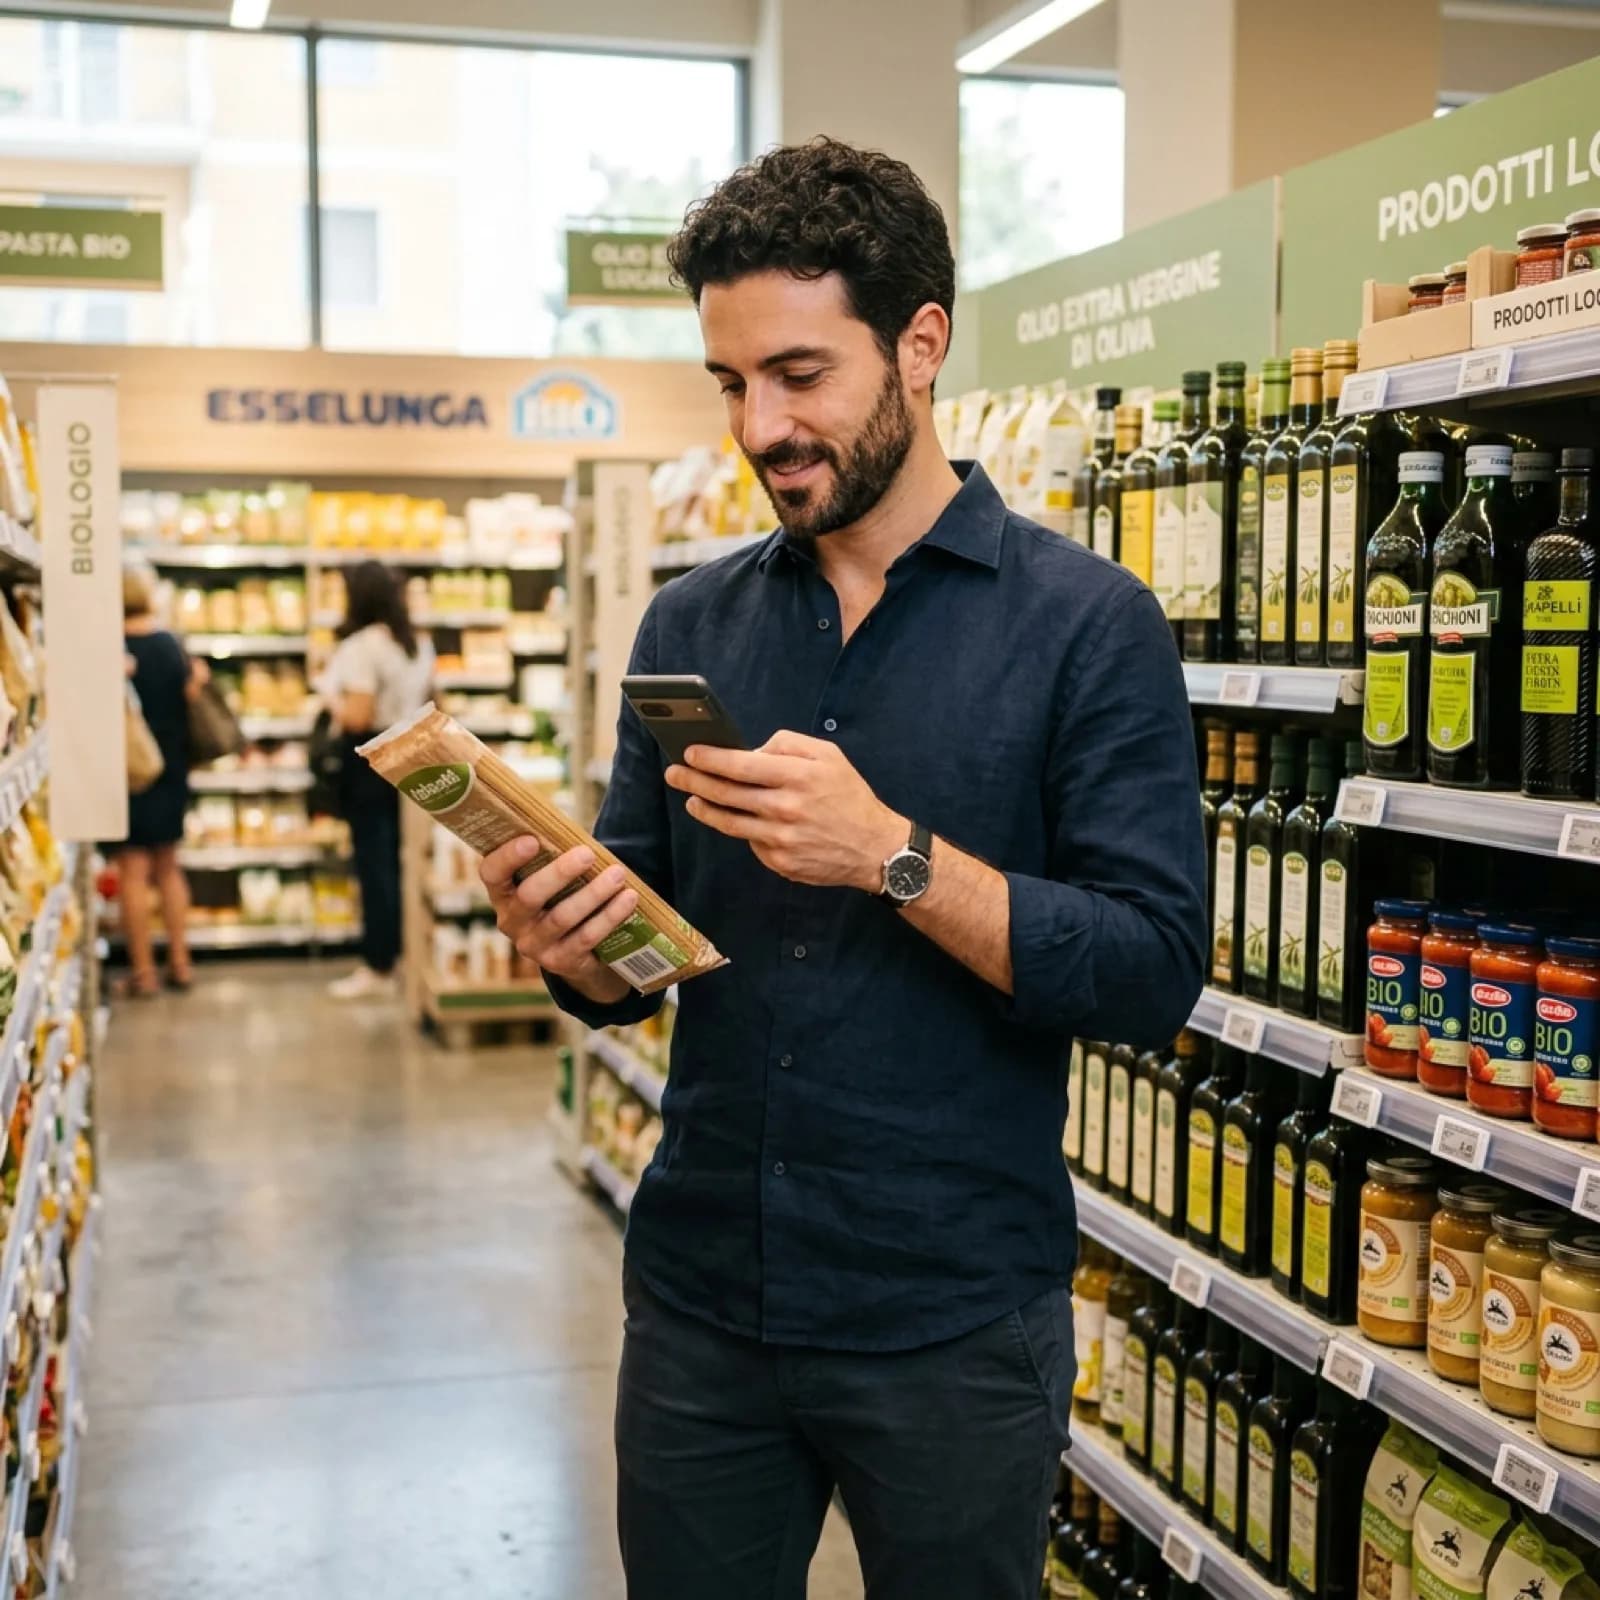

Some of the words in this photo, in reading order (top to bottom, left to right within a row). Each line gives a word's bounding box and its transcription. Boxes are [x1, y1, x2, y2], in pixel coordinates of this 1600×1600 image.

[1378, 143, 1554, 242] PRODOTTI
[0, 230, 79, 258] PASTA
[82, 233, 132, 260] BIO
[1016, 302, 1061, 344] OLIO
[1062, 283, 1126, 332] EXTRA
[1127, 249, 1222, 312] VERGINE
[1493, 294, 1570, 330] PRODOTTI
[1070, 332, 1093, 370] DI
[1096, 315, 1156, 363] OLIVA
[206, 389, 488, 428] ESSELUNGA
[68, 422, 94, 575] BIOLOGIO
[1367, 976, 1403, 1006] BIO
[1470, 1006, 1508, 1039] BIO
[1535, 1021, 1573, 1056] BIO
